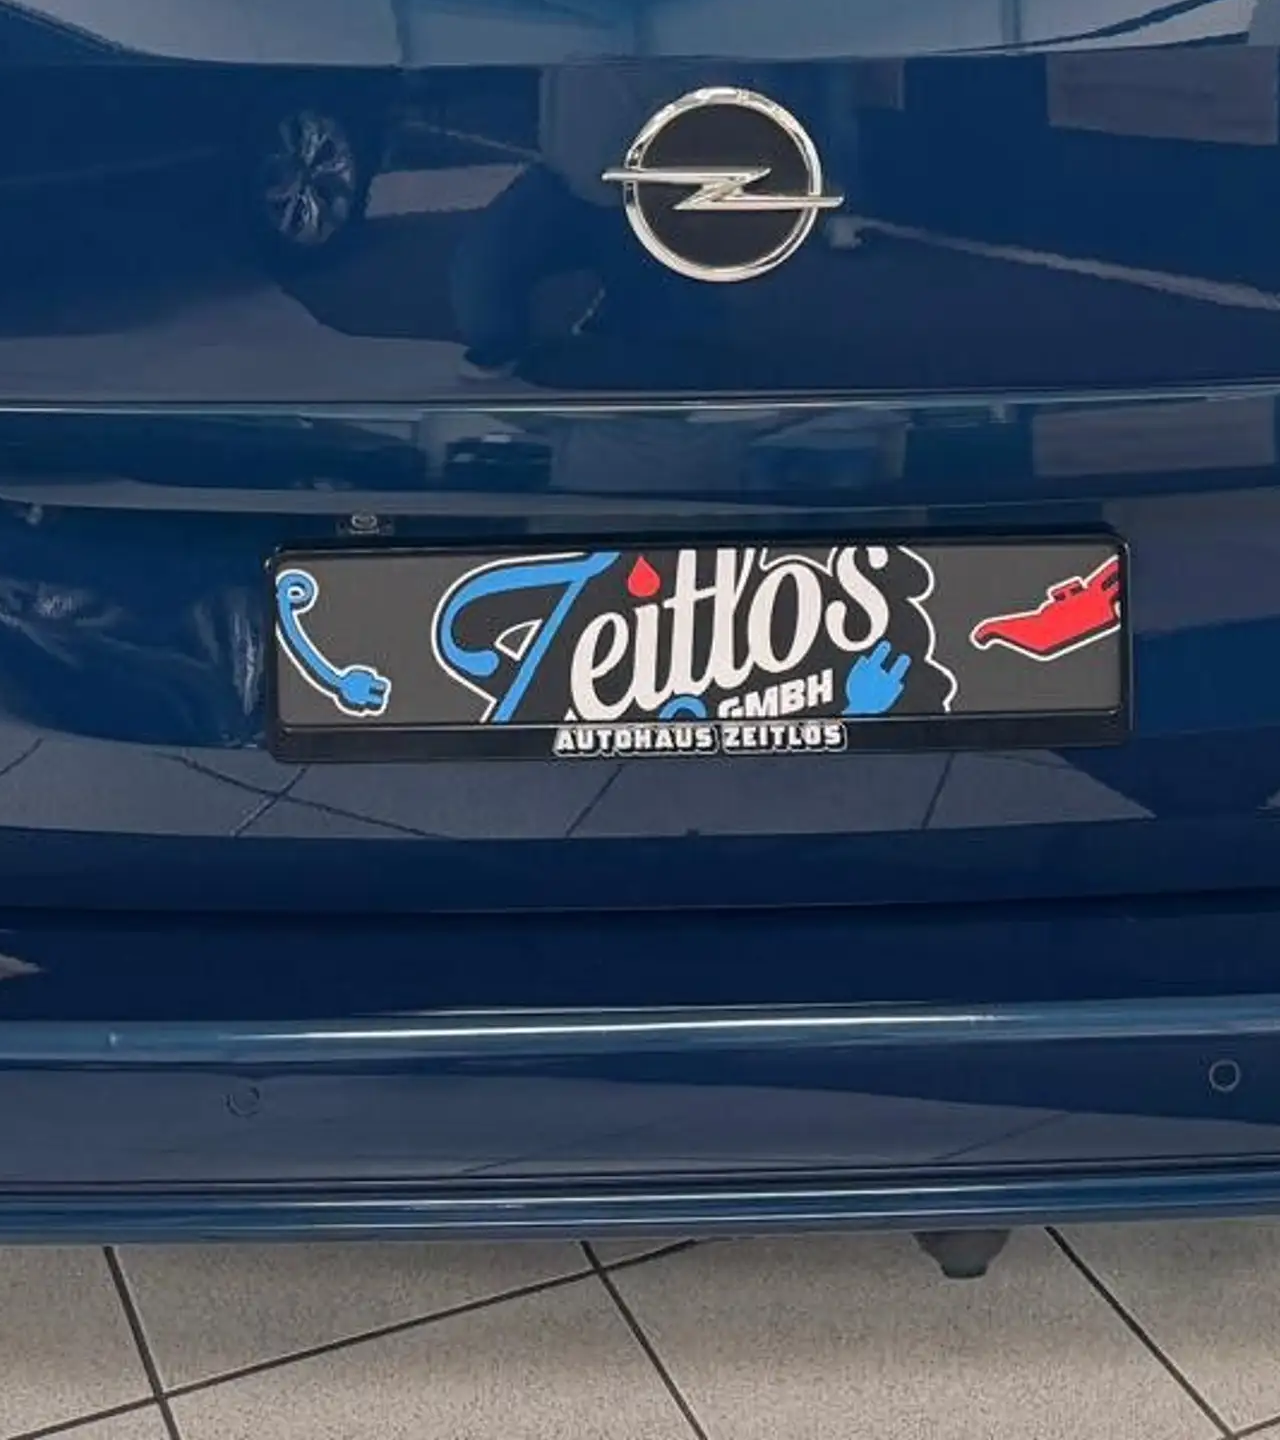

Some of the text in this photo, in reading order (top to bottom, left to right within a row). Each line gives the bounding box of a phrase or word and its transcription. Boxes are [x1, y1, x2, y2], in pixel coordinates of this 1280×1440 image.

[718, 669, 834, 720] GMBH
[555, 723, 843, 752] AUTOHAUS ZEITLOS
